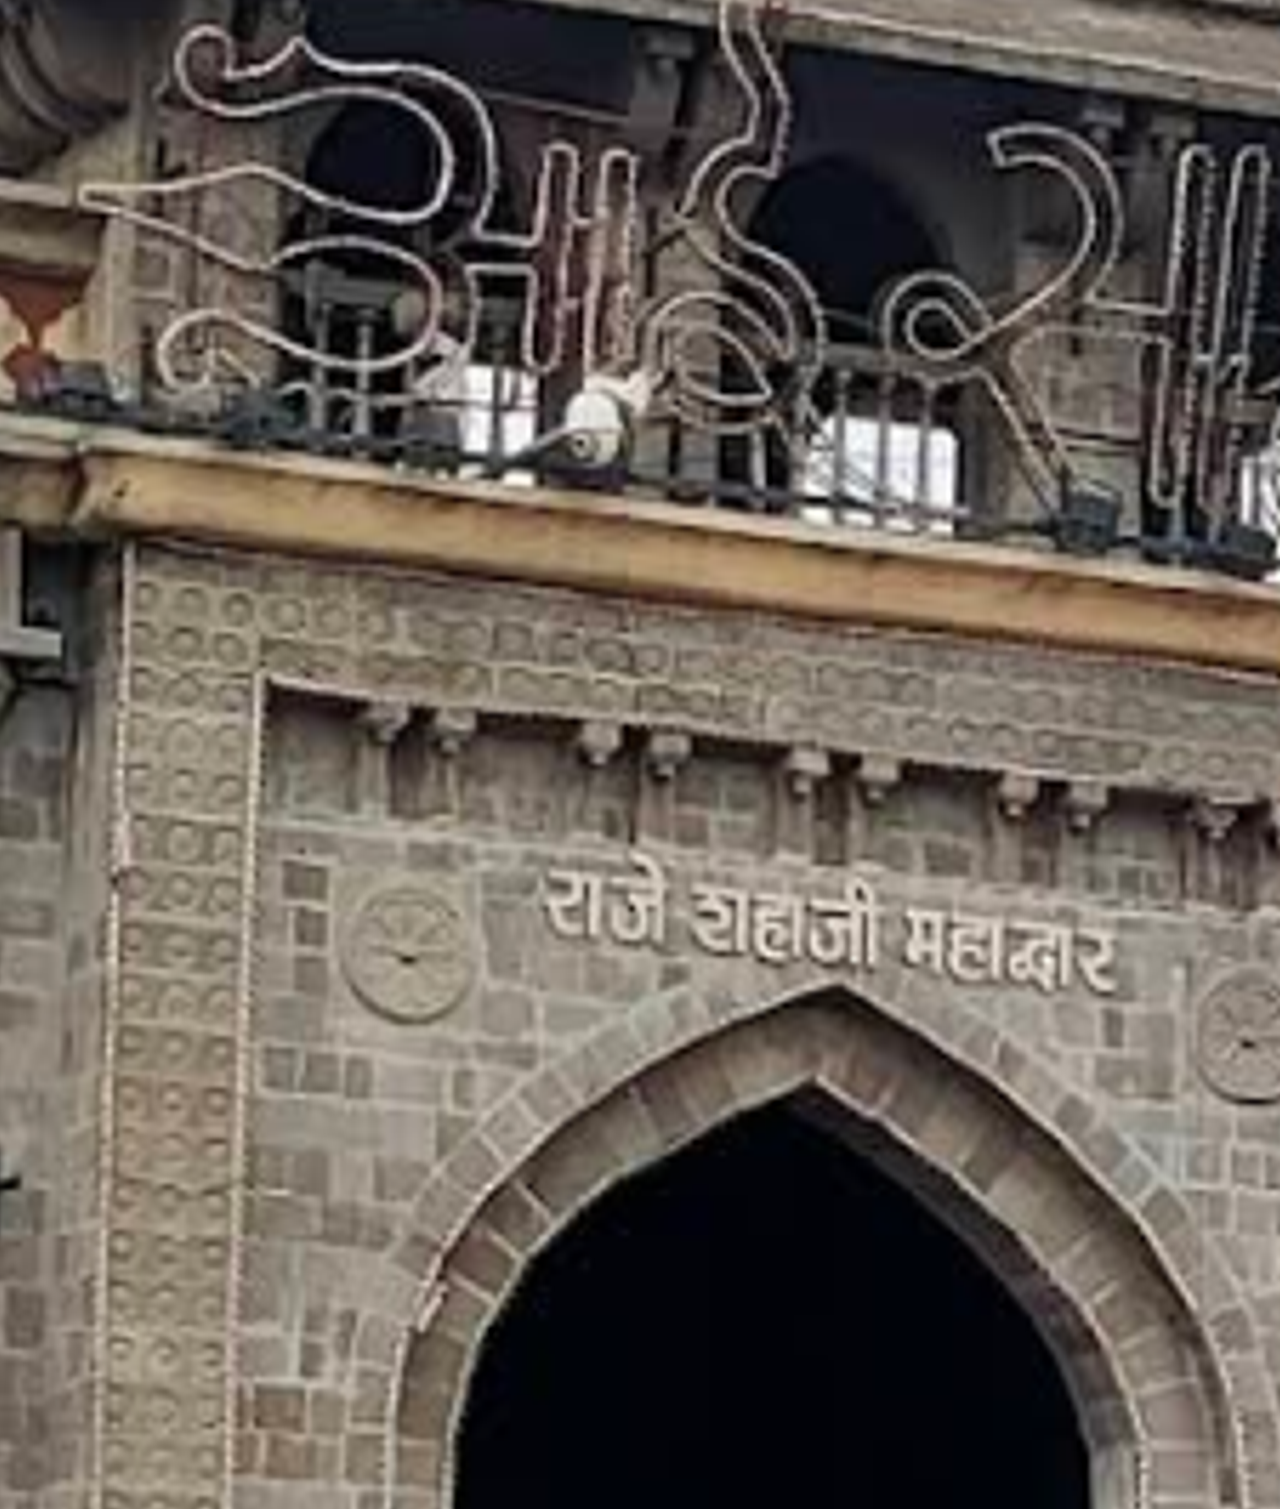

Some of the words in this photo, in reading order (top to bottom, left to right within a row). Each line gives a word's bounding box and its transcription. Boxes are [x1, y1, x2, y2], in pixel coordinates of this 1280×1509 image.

[544, 851, 665, 943] राजे
[690, 879, 879, 968] शहाजी
[904, 905, 1120, 993] महाद्वार
